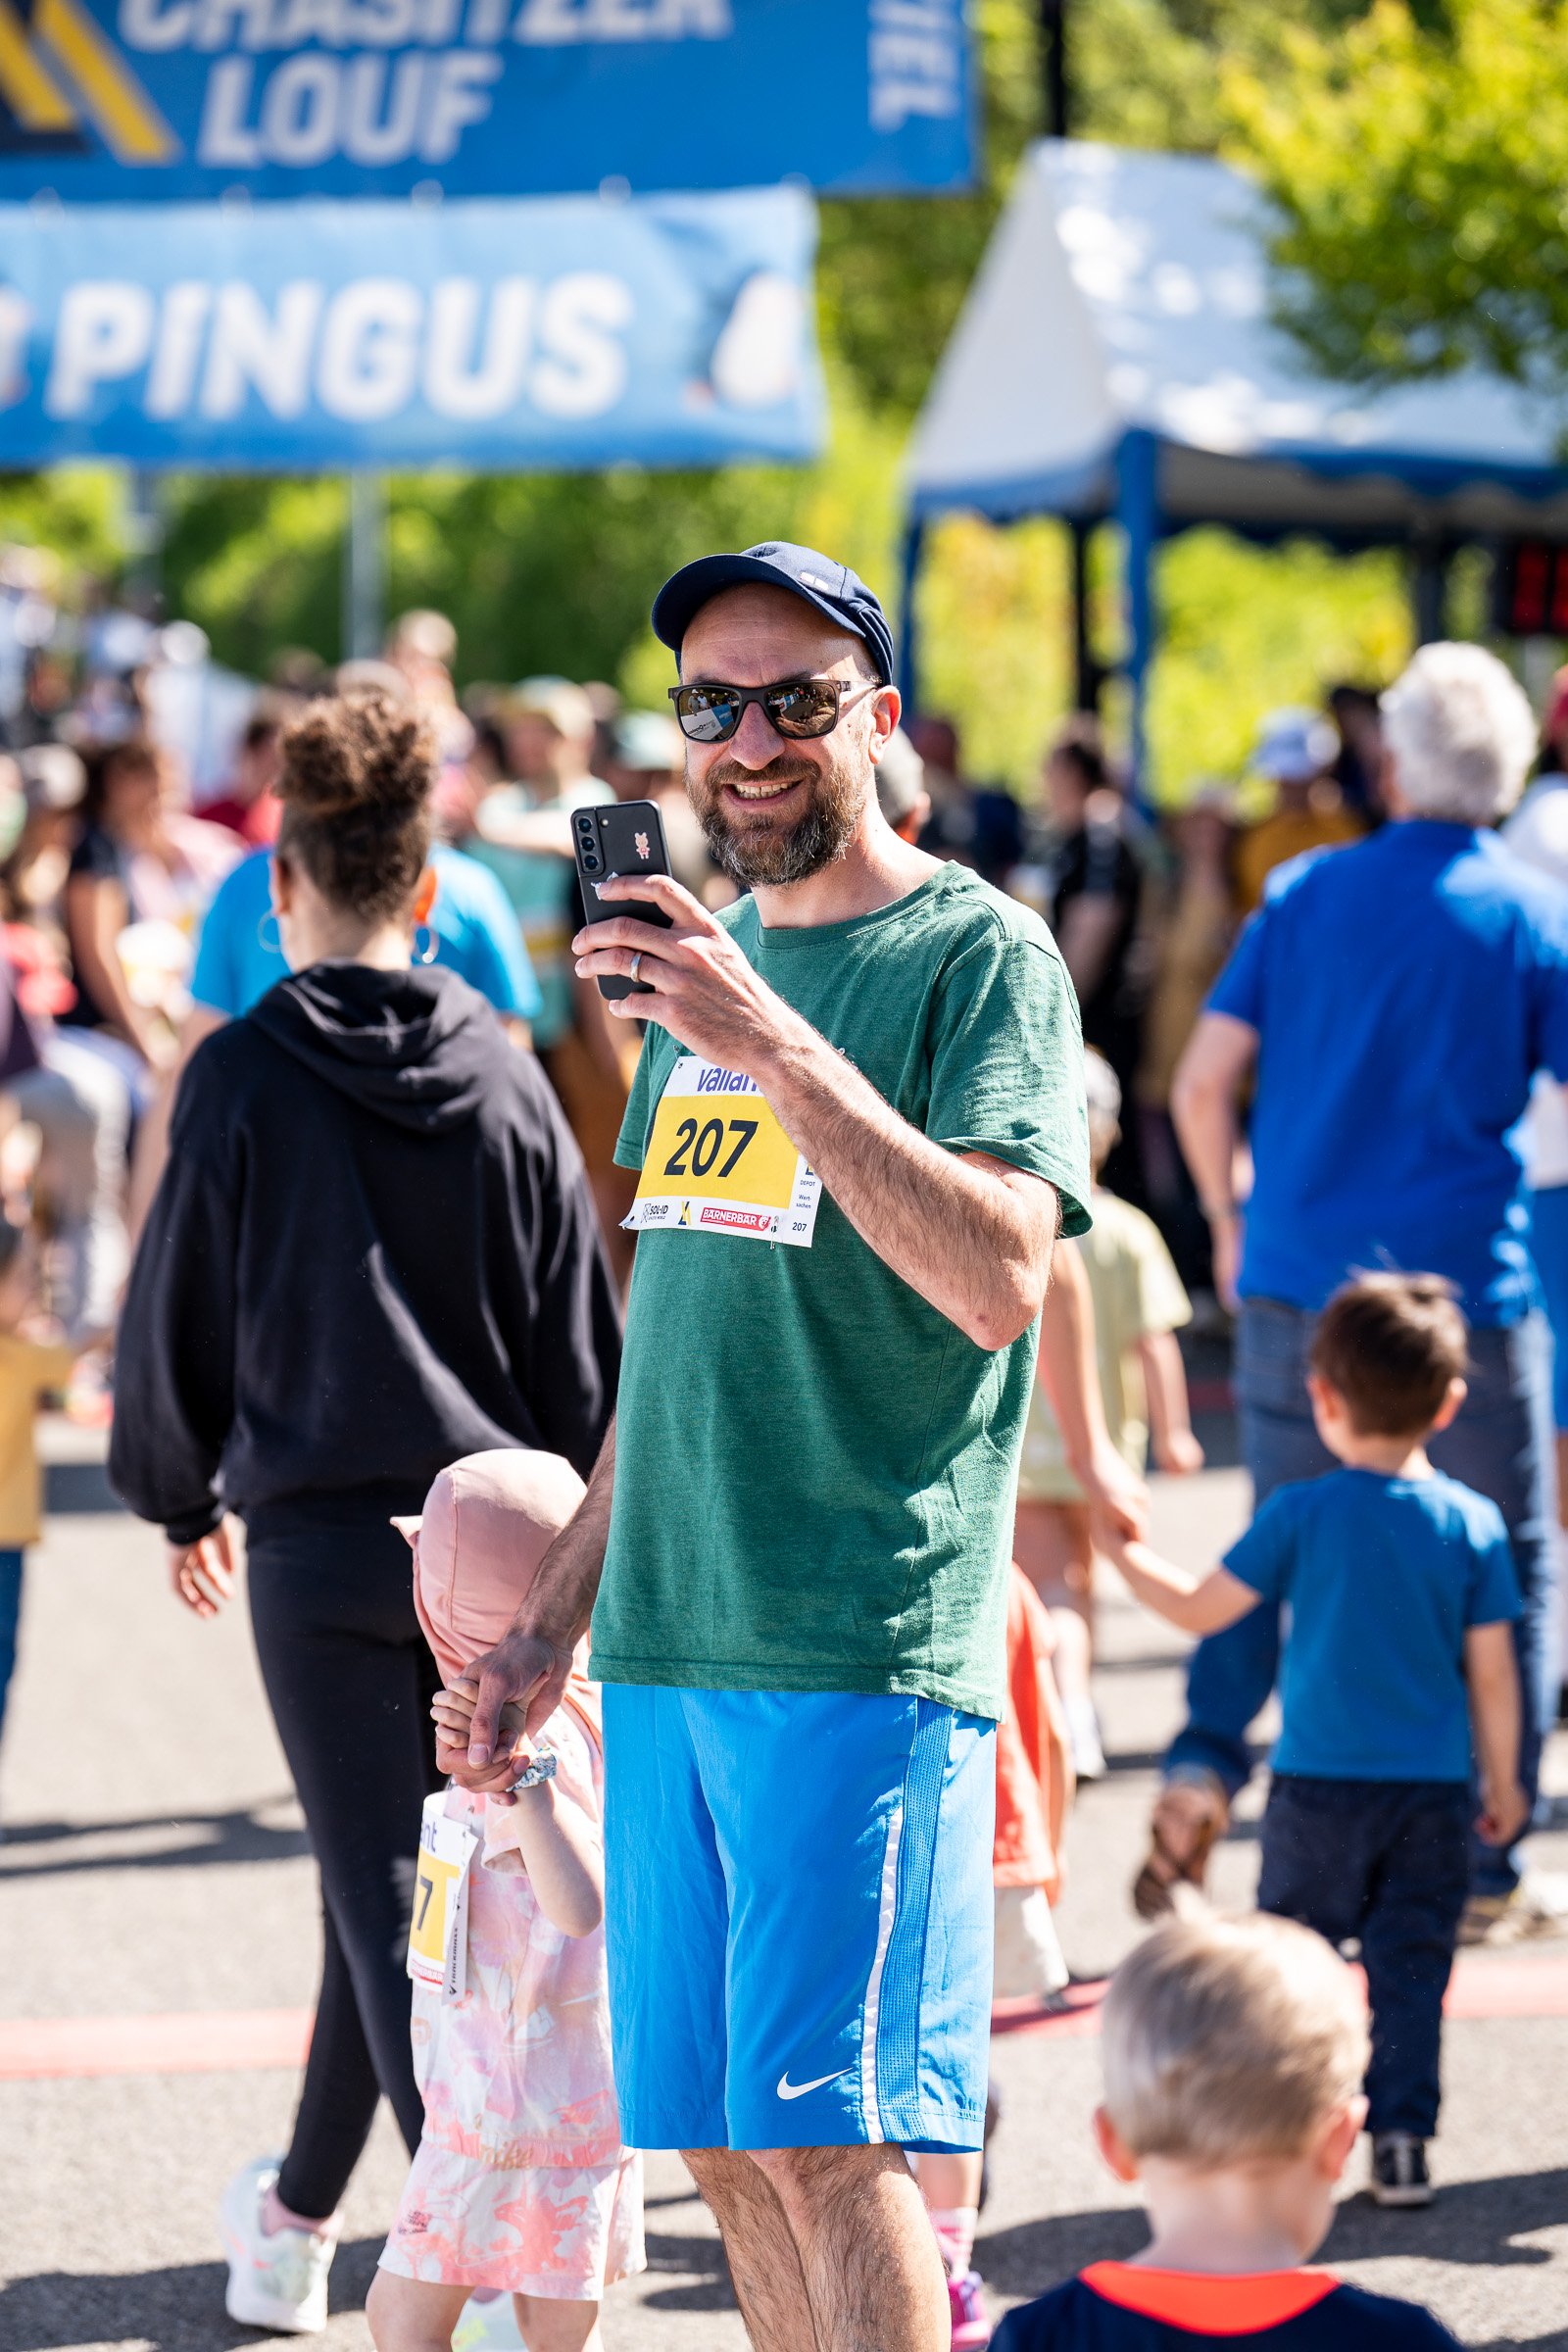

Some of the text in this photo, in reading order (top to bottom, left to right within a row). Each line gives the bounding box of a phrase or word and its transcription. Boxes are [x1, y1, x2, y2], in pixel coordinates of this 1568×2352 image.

[867, 0, 958, 134] IEL
[199, 51, 503, 168] LOUF
[47, 275, 633, 421] PINGUS
[697, 1067, 758, 1093] valia
[663, 1117, 760, 1178] 207
[792, 1221, 808, 1232] 207
[417, 1874, 433, 1932] 7
